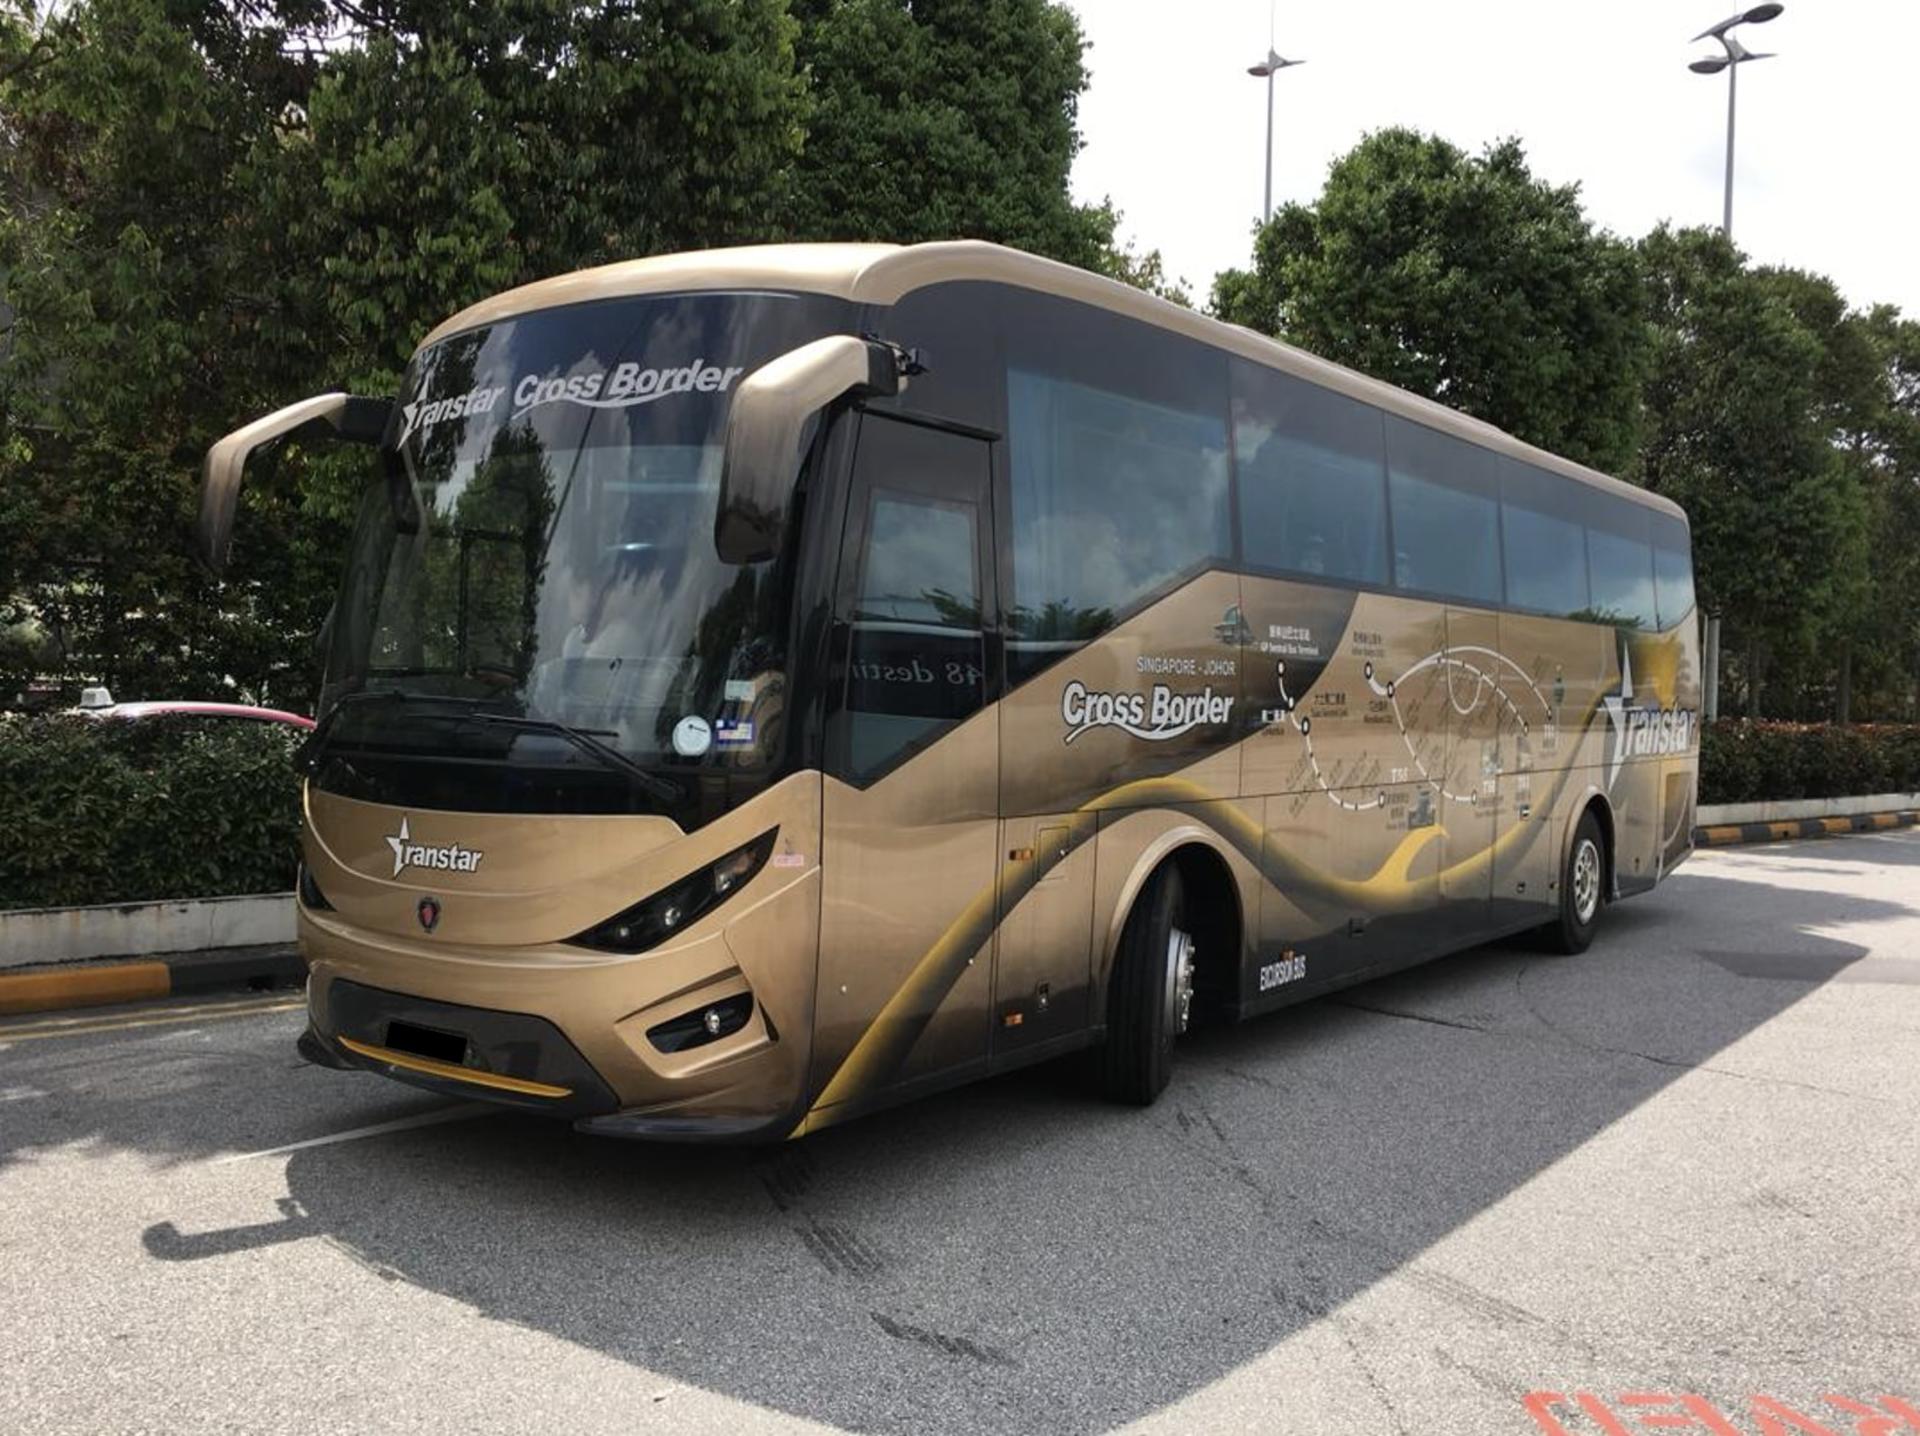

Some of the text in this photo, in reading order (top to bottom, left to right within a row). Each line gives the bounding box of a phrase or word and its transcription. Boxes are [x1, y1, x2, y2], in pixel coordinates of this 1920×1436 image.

[396, 359, 743, 450] Transtar Cross Border
[1136, 656, 1196, 676] SINGAPORE
[1203, 660, 1237, 677] JOHOR
[1063, 681, 1235, 726] Cross Border
[385, 815, 484, 881] Transtar
[1294, 955, 1306, 979] BUS
